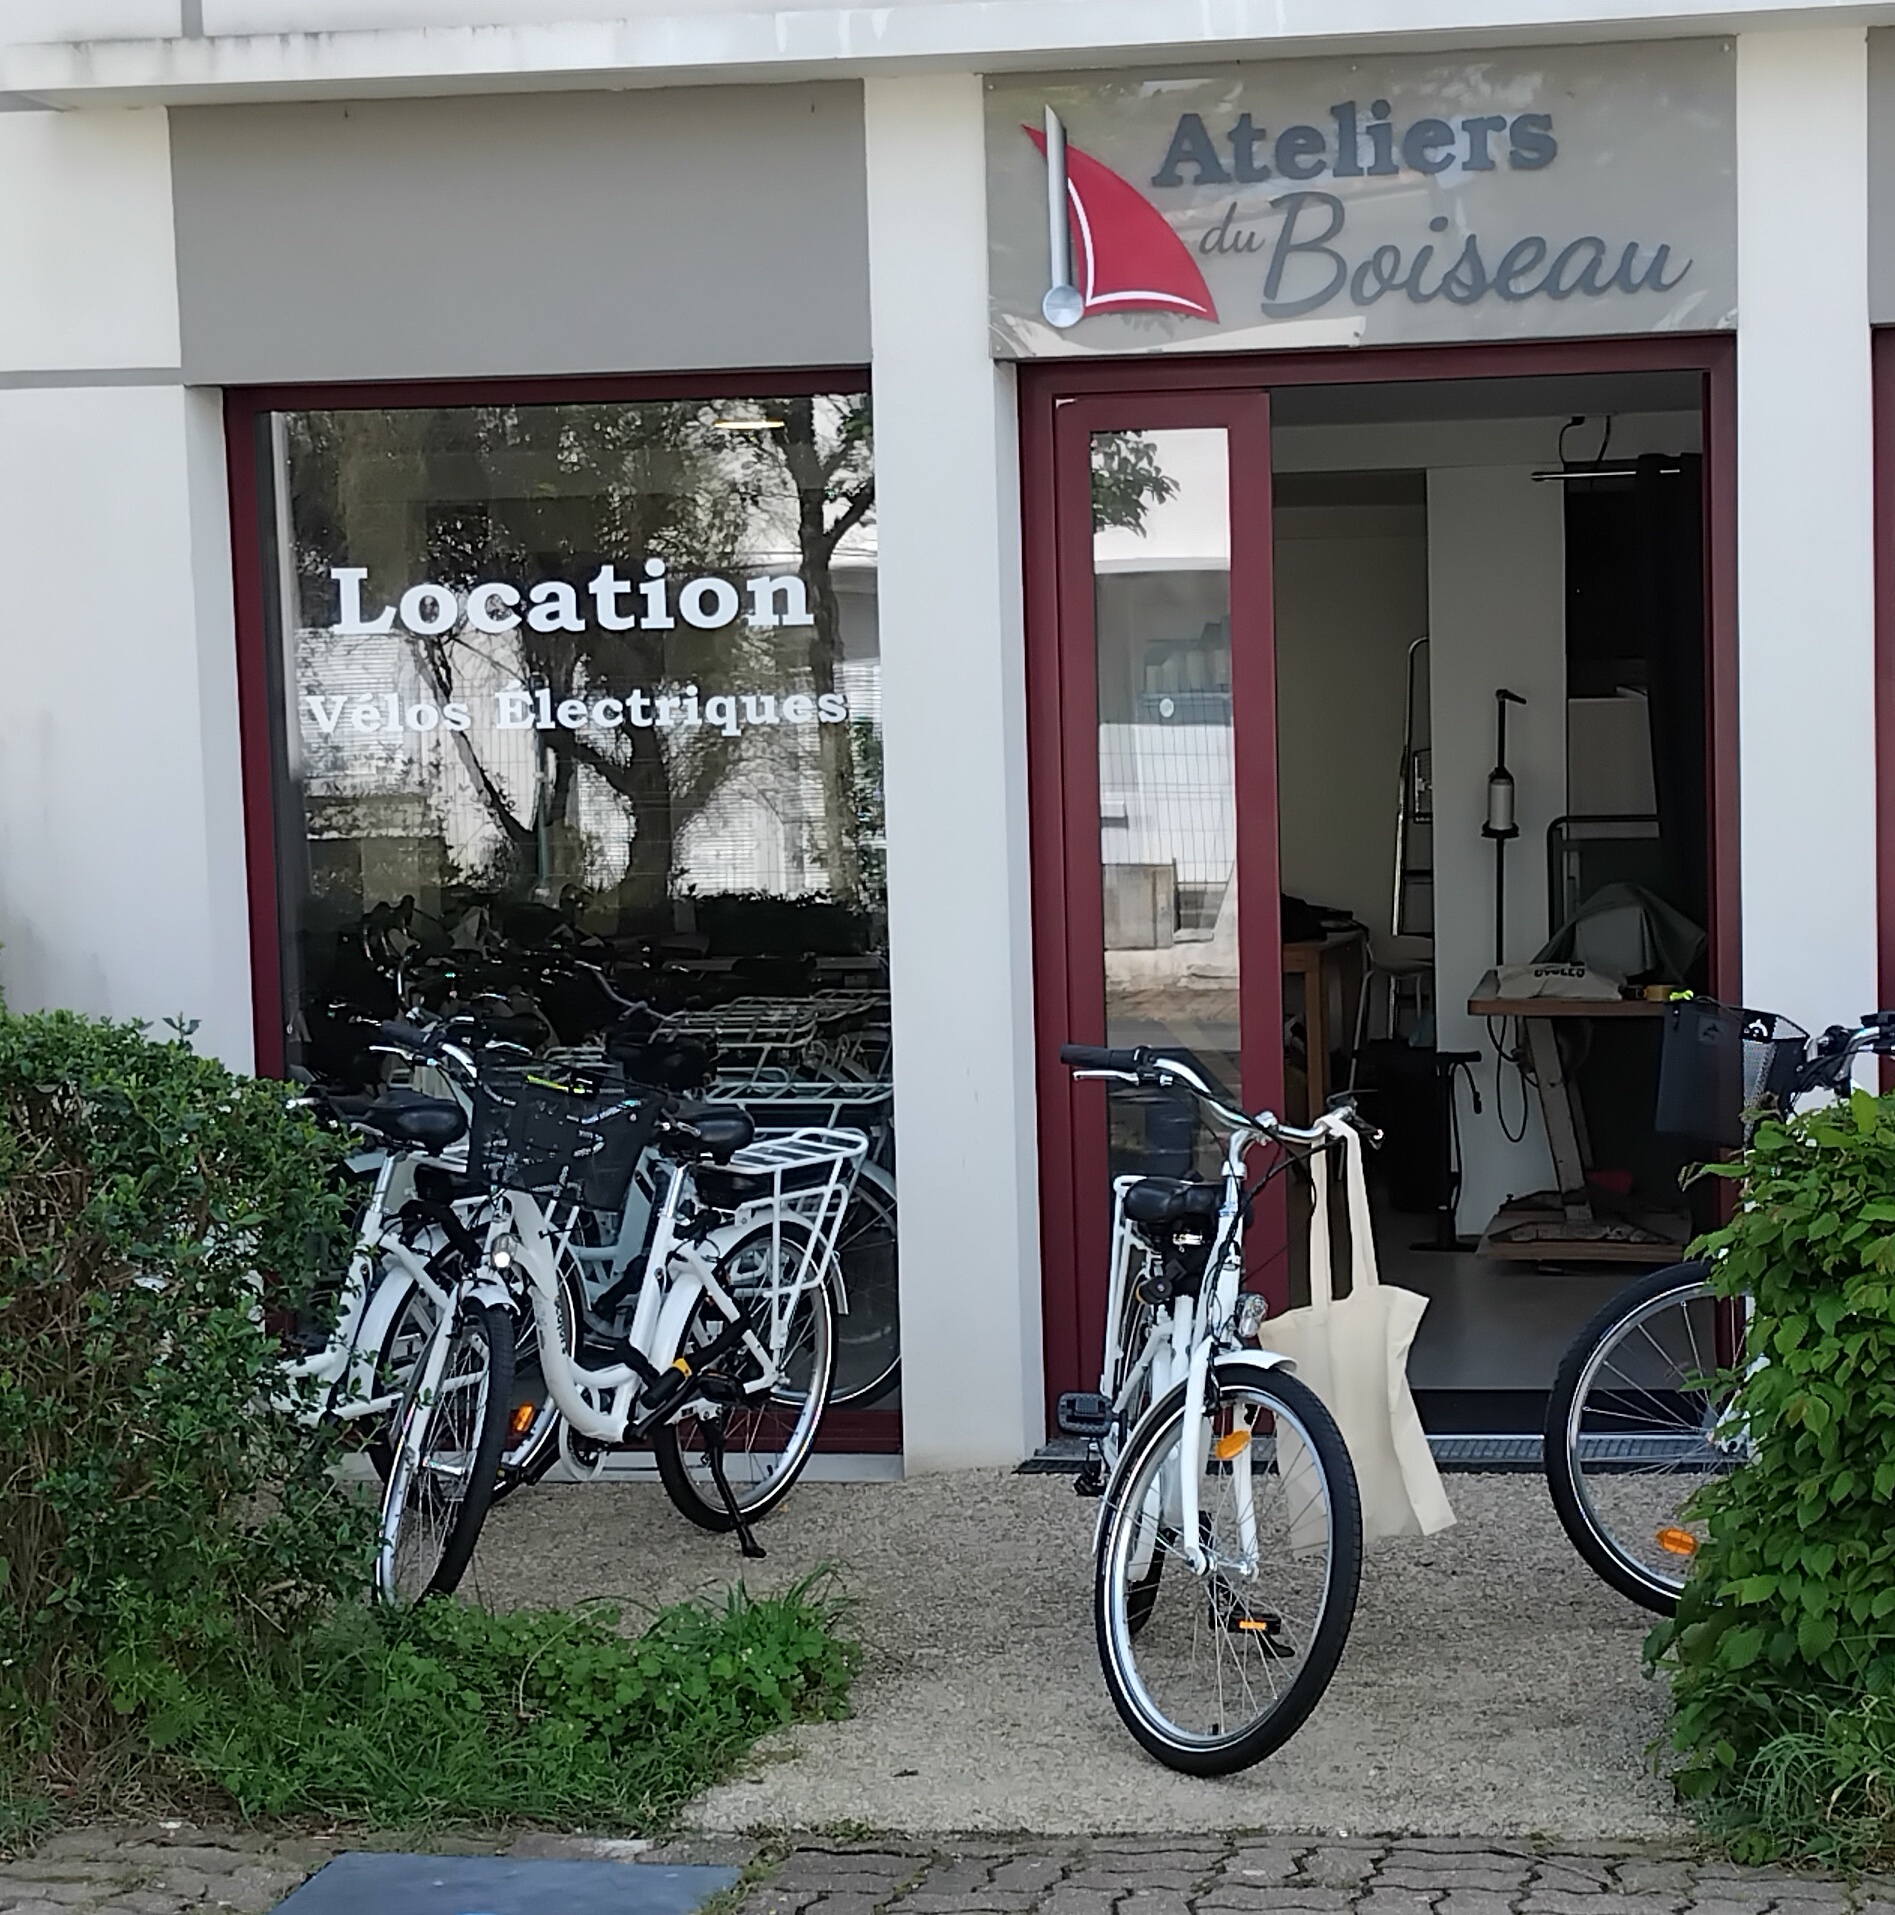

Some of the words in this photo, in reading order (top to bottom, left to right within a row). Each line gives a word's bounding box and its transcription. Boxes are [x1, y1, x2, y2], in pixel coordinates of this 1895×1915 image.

[1151, 99, 1558, 187] Ateliers
[1200, 202, 1263, 256] du
[1261, 190, 1693, 317] Boiseau
[329, 558, 814, 634] Location
[306, 689, 471, 733] Vélos
